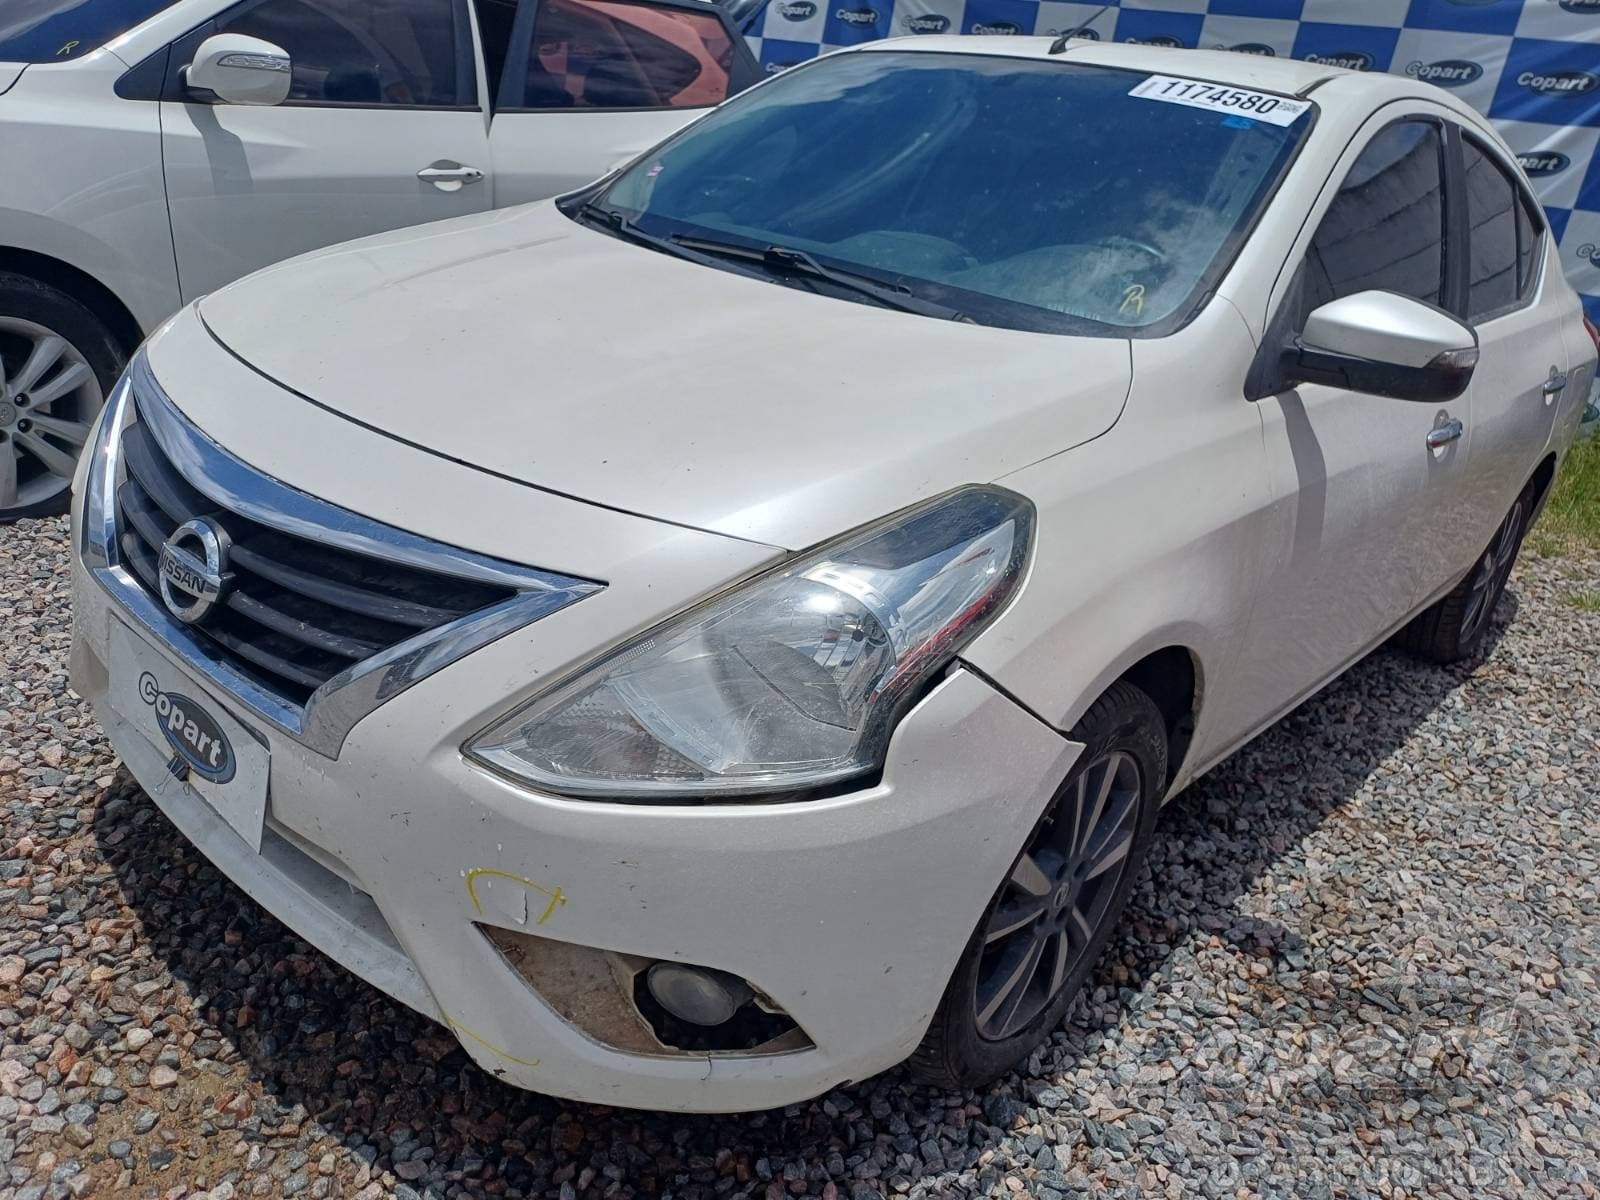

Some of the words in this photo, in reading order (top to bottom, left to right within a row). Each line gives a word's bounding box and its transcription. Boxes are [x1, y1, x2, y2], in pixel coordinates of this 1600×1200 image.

[775, 2, 812, 17] Copart
[836, 9, 876, 23] Copart
[902, 15, 945, 31] Copart
[1406, 61, 1473, 80] Copart
[1517, 72, 1590, 91] Copart
[1161, 81, 1281, 114] 1174580
[159, 550, 206, 594] NISSAN
[139, 671, 221, 768] Copart
